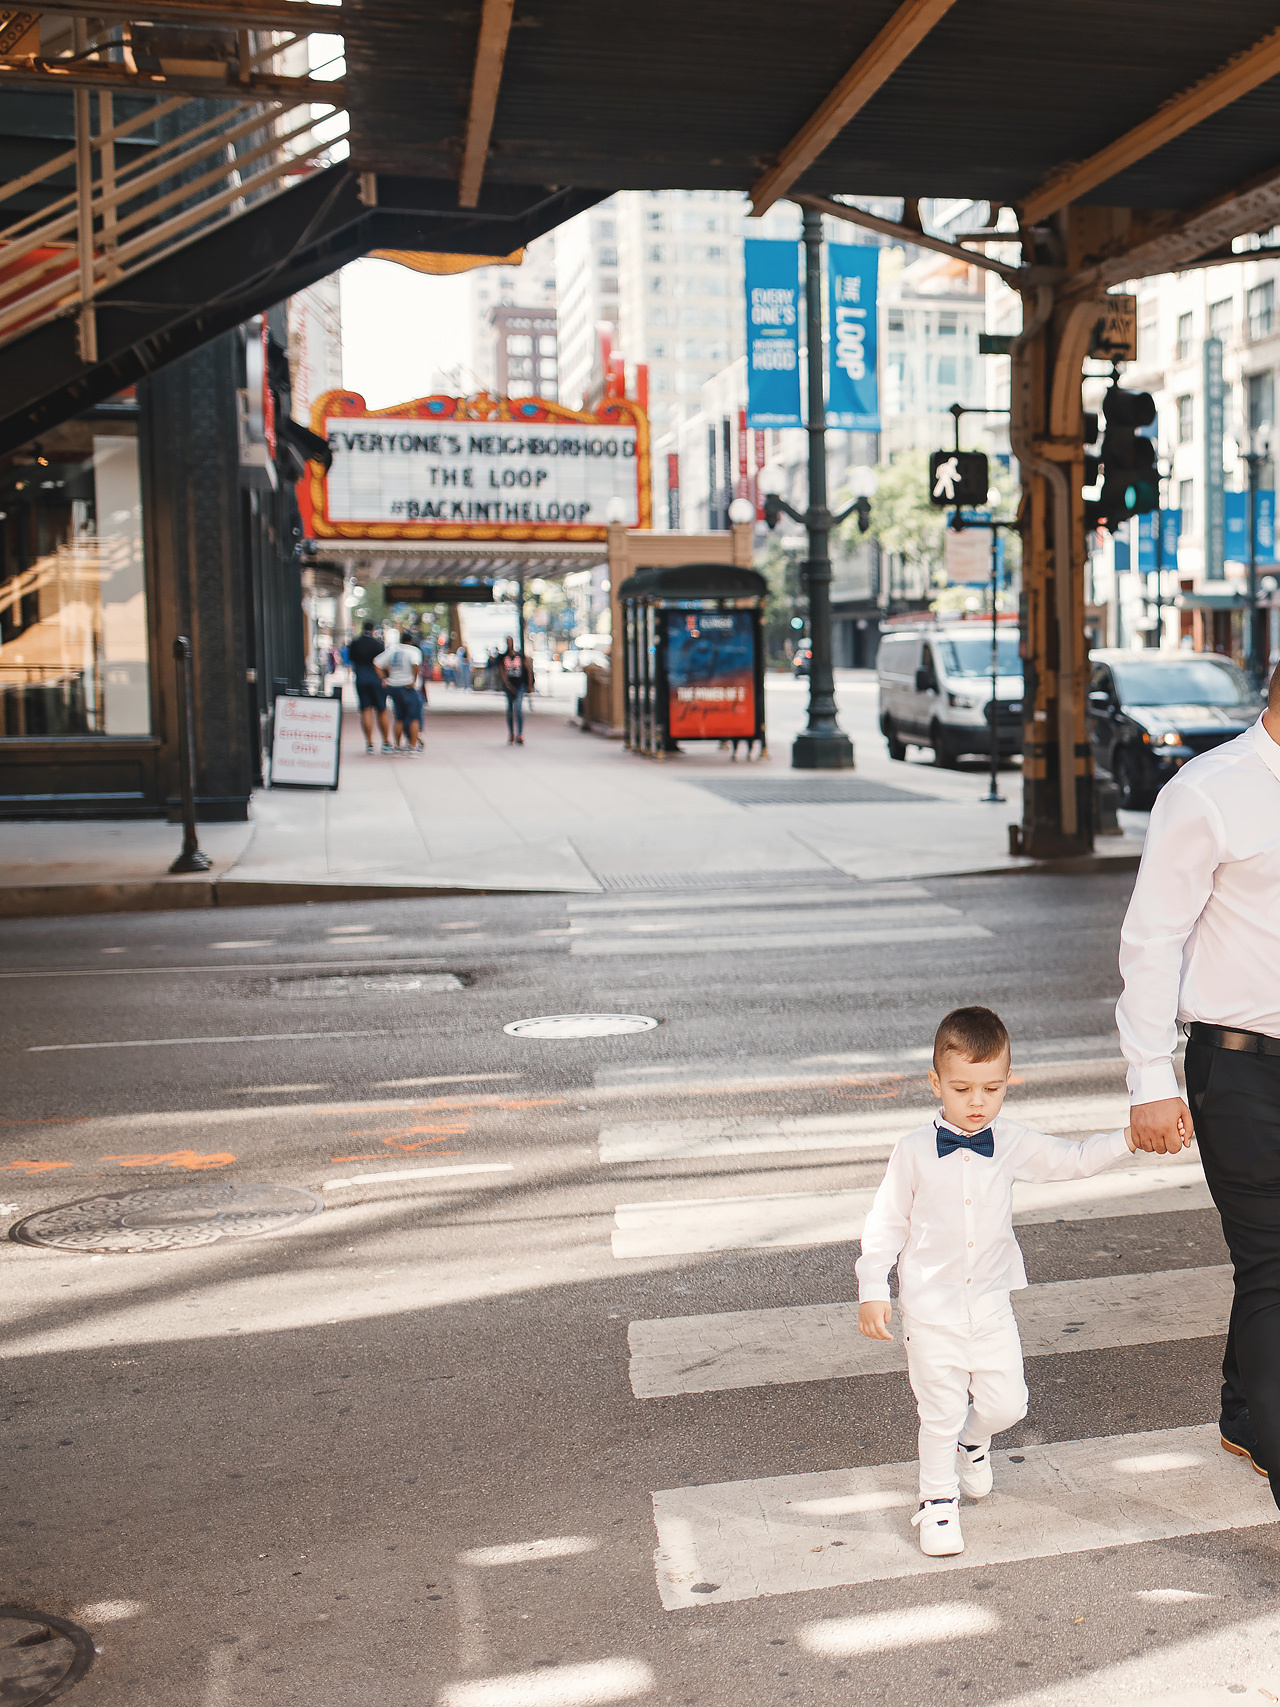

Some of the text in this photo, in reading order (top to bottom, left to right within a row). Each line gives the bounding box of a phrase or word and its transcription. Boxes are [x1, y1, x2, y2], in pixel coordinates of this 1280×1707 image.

[751, 288, 795, 305] EVERY
[751, 304, 796, 325] ONE'S
[836, 306, 867, 380] LOOP
[752, 350, 797, 371] HOOD
[328, 432, 636, 457] EVERYONE'S NEIGHBORHOOD
[429, 466, 547, 488] THE LOOP
[391, 501, 591, 522] #BACKINTHELOOP
[279, 727, 333, 741] Entrance
[291, 741, 319, 754] Only
